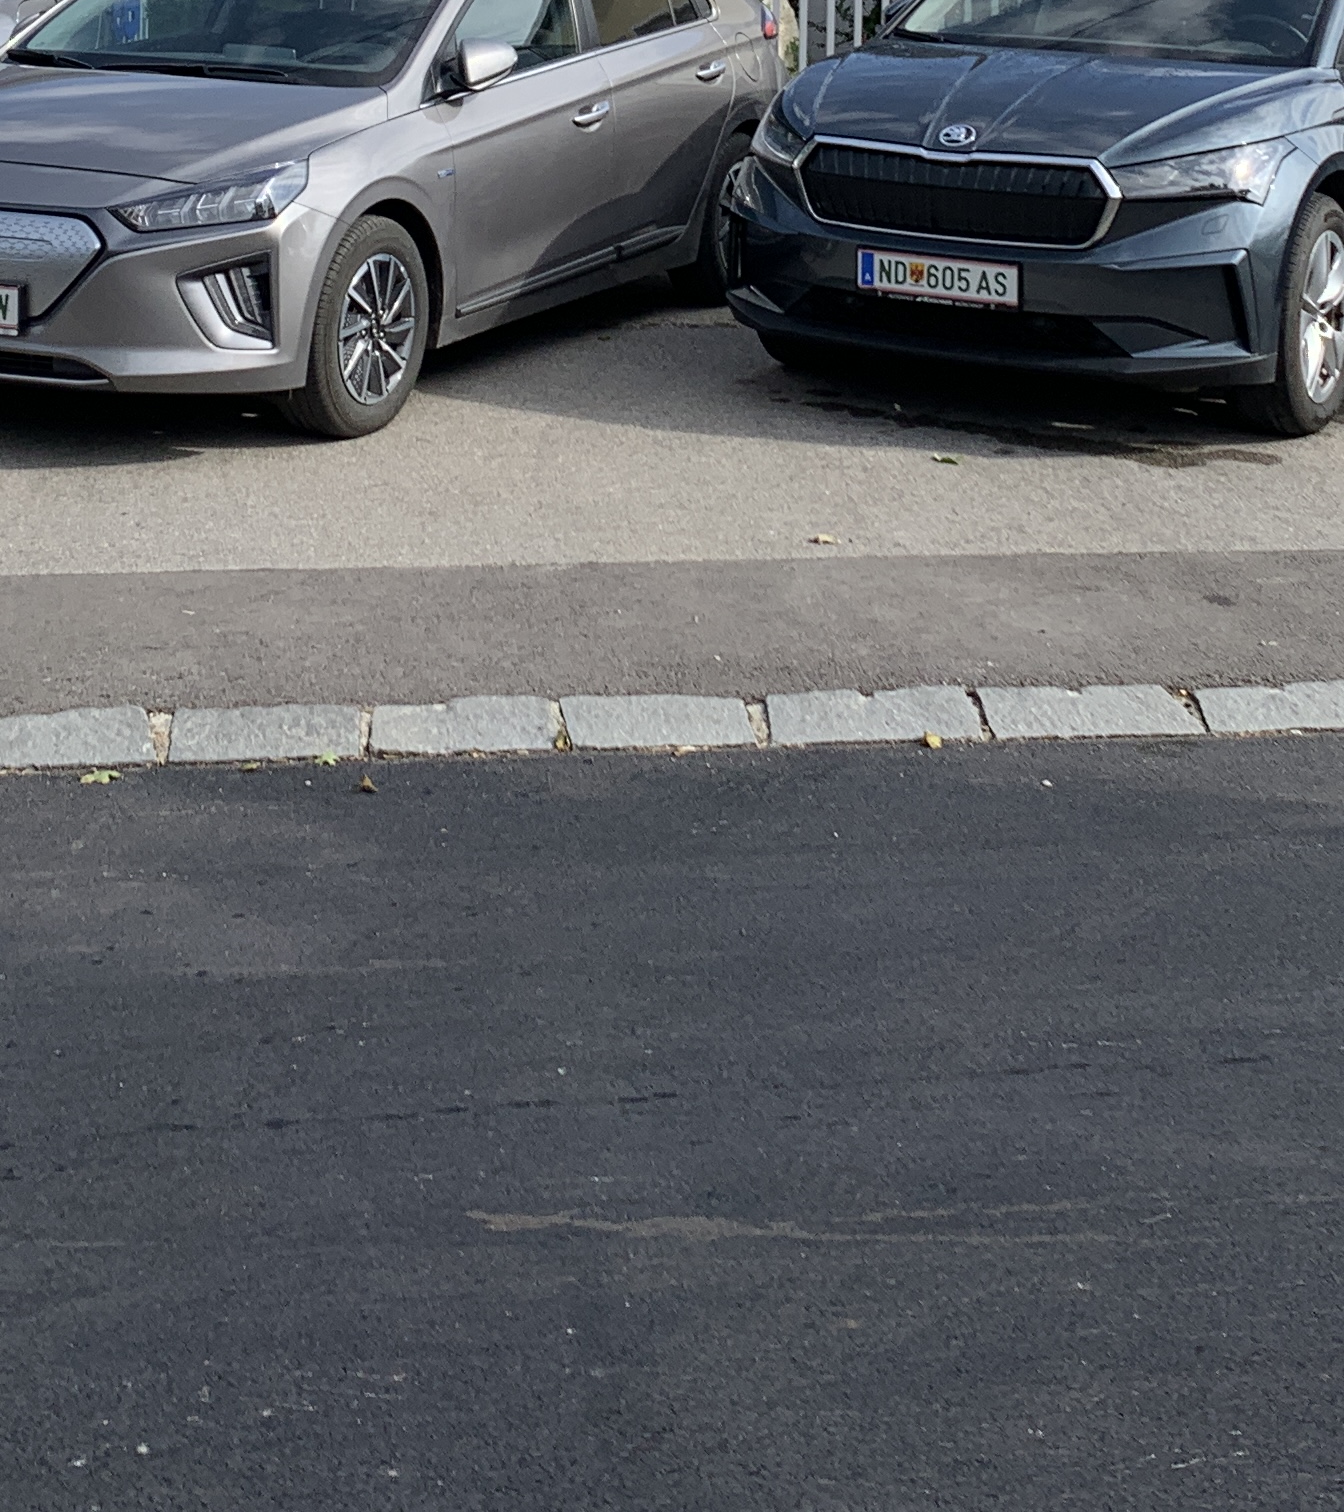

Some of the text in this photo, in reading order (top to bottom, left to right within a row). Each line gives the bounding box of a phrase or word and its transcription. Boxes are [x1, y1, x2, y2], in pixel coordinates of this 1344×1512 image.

[879, 258, 1007, 297] ND 605 AS
